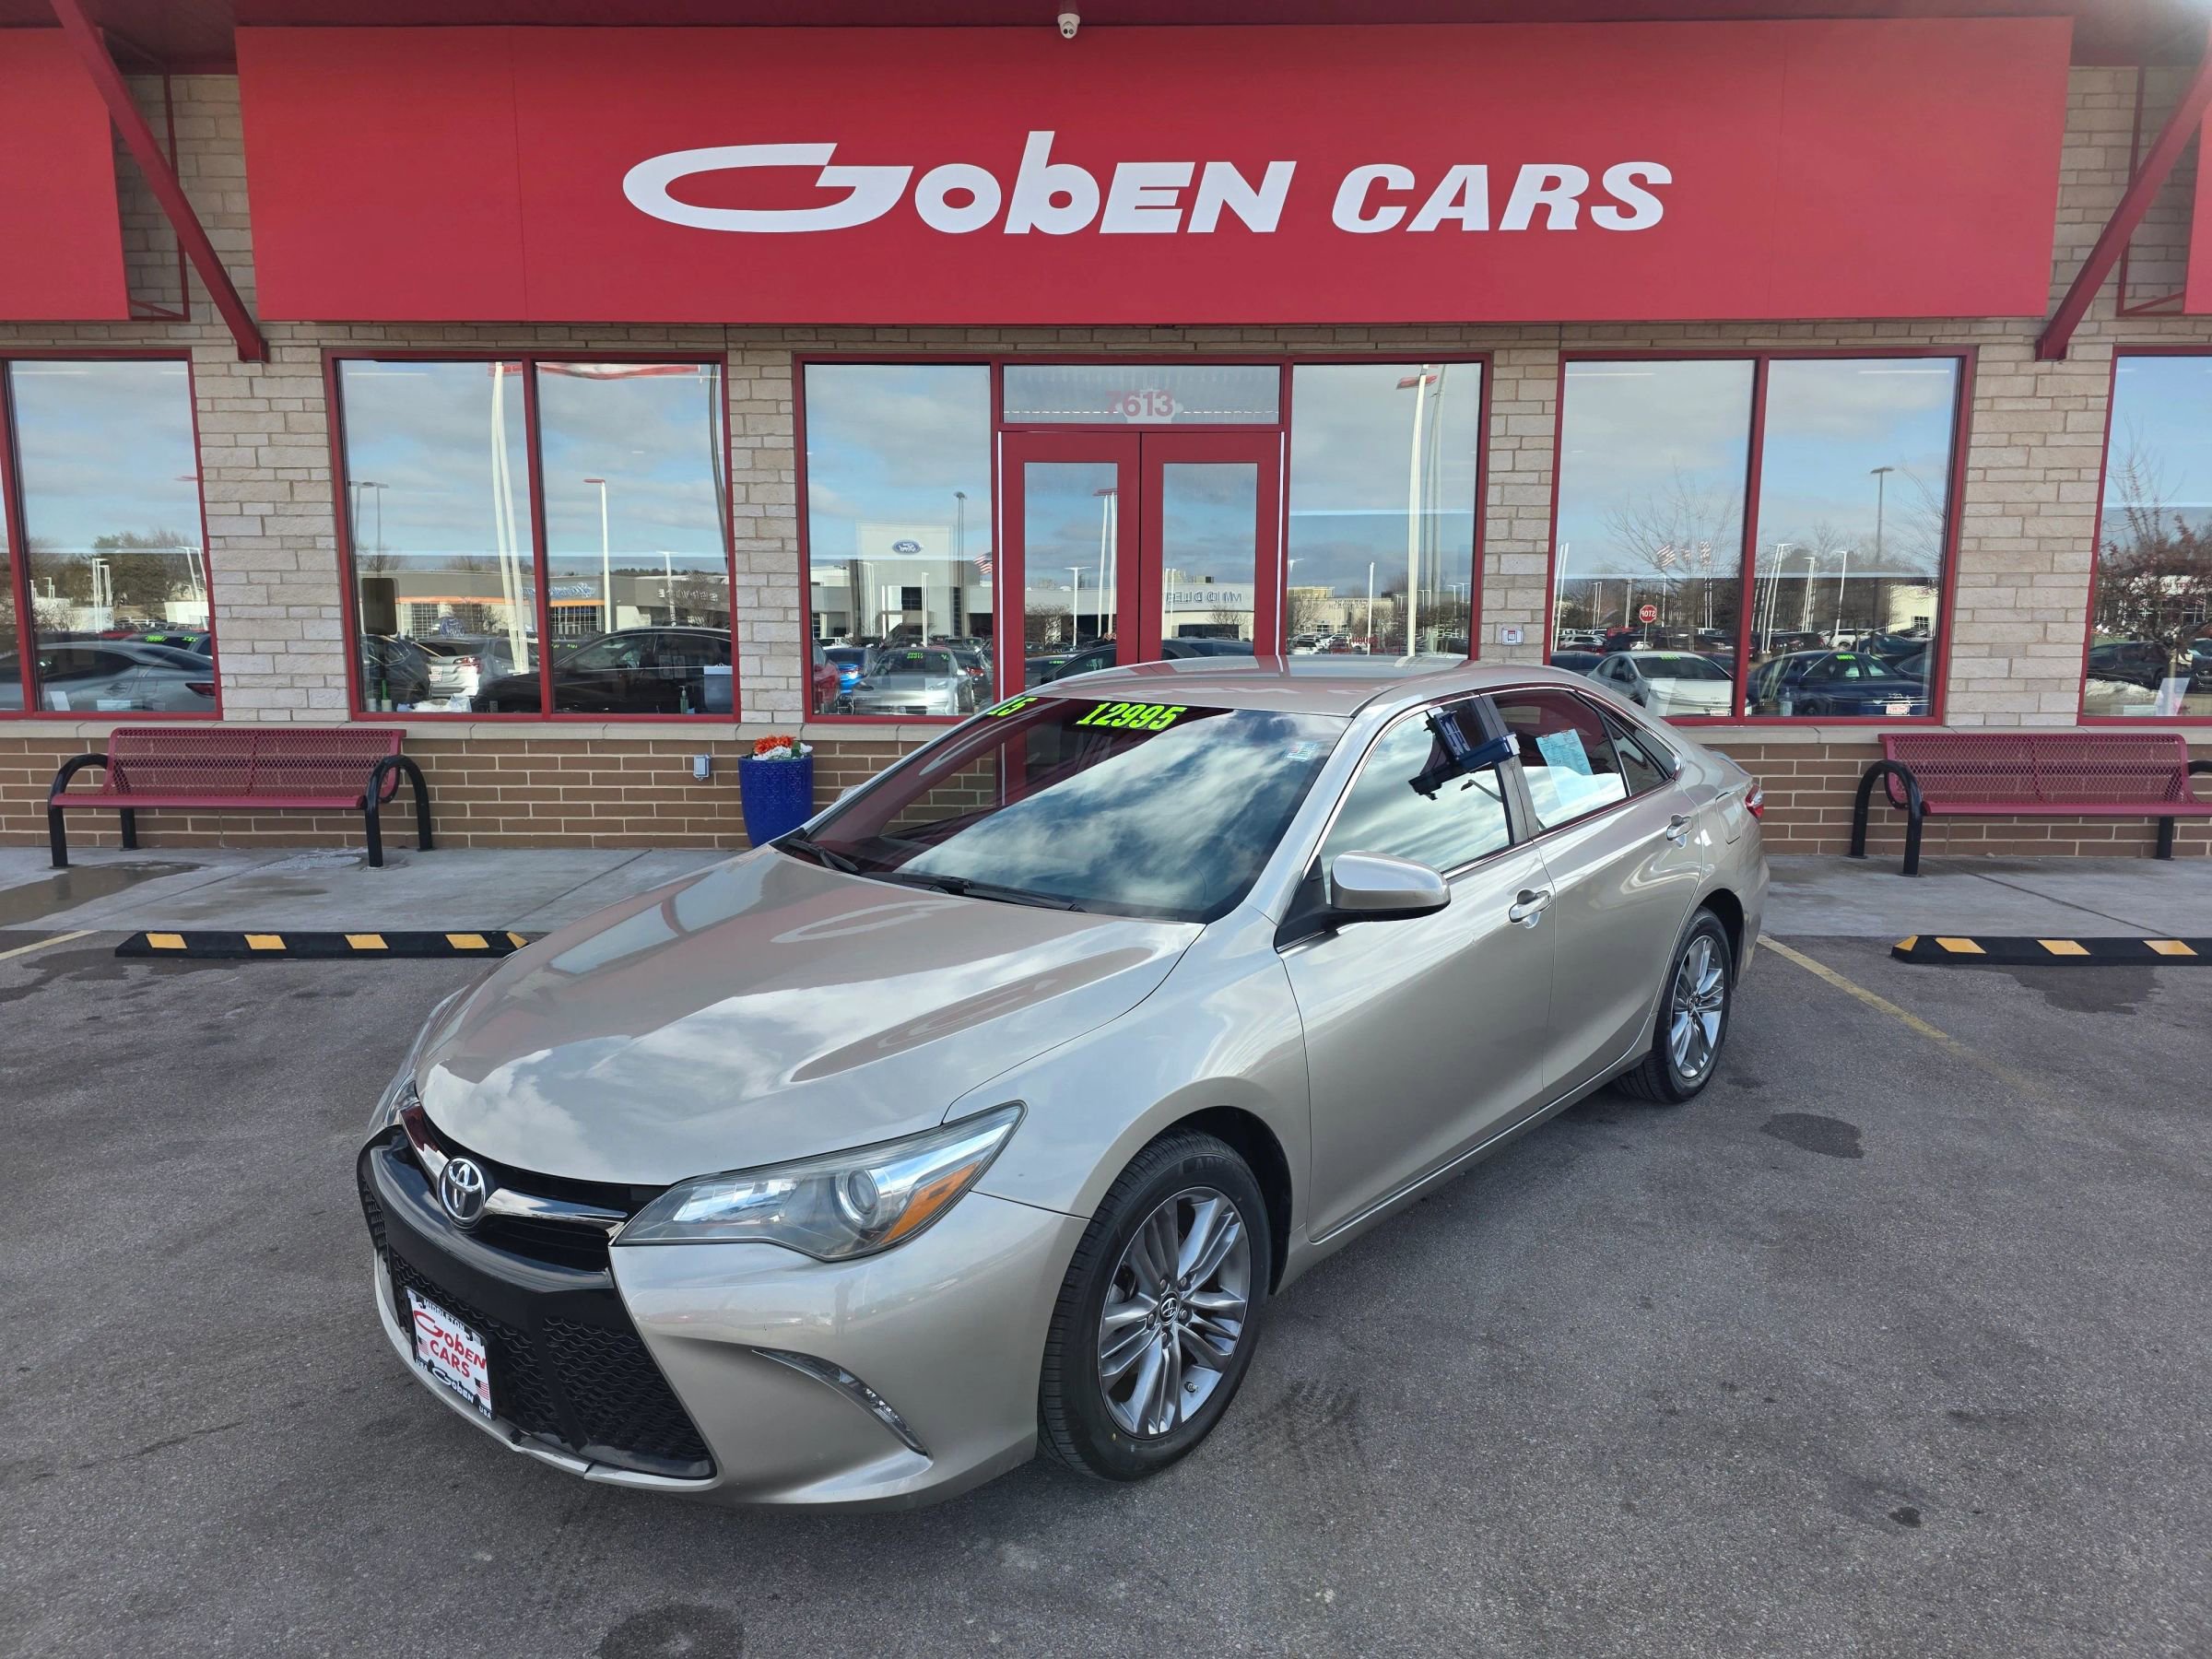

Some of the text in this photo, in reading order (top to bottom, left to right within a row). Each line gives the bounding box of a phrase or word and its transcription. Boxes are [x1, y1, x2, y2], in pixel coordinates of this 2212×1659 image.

[1331, 161, 1673, 233] CARS
[1106, 389, 1173, 417] 7613
[986, 697, 1039, 716] 15
[1076, 702, 1188, 731] 12995
[429, 1339, 471, 1378] CARS
[478, 1405, 492, 1420] USA
